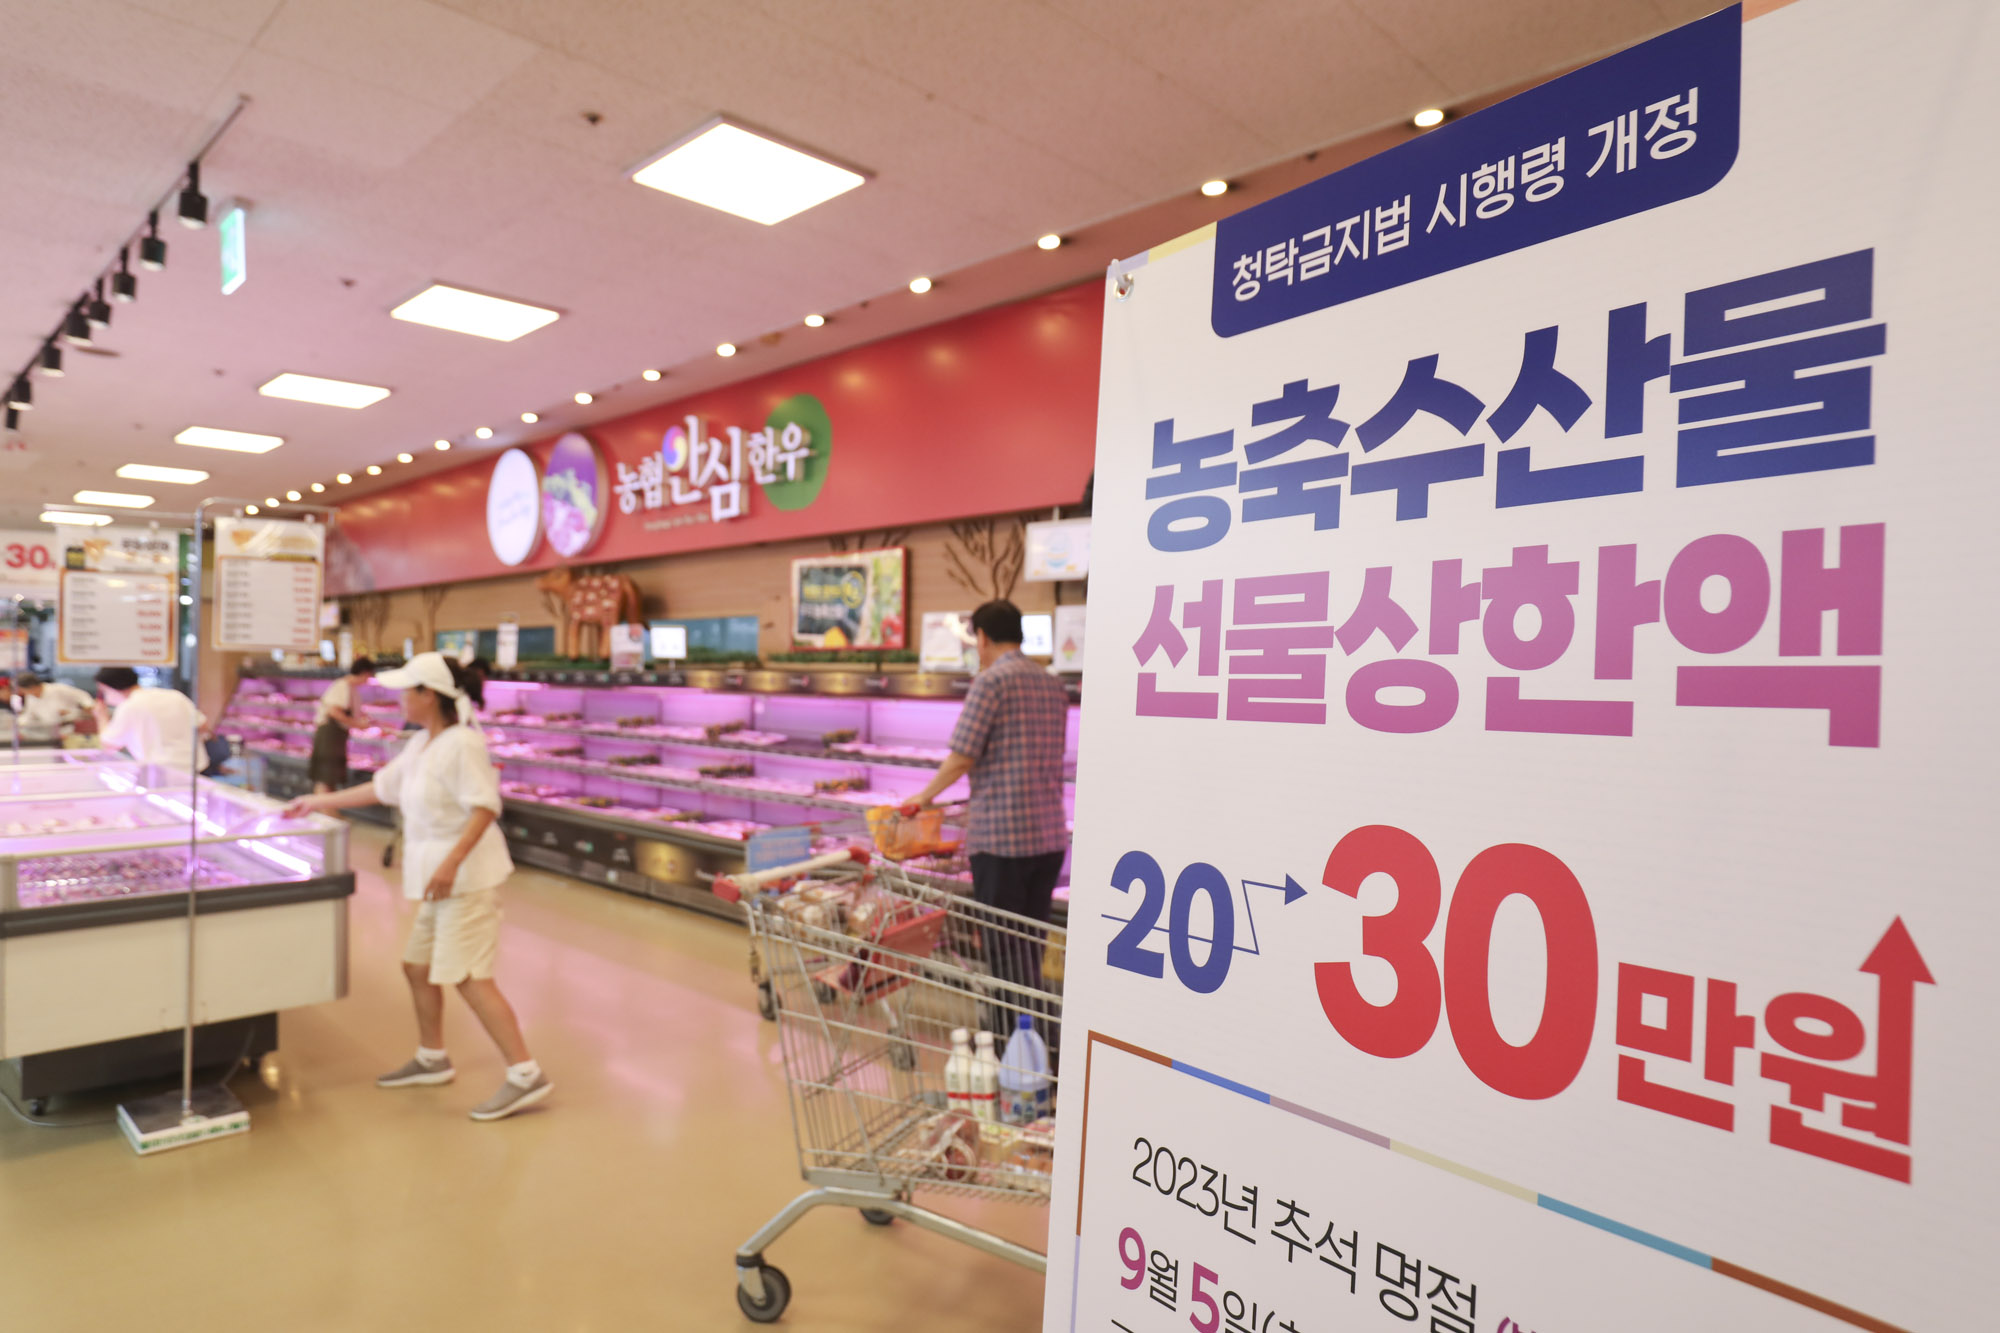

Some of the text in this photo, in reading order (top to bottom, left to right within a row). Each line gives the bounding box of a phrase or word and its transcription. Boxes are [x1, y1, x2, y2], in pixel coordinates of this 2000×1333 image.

[1232, 86, 1700, 302] 청탁금지법 시행령 개정
[1145, 247, 1887, 553] 농축수산물
[5, 543, 56, 571] 30
[1131, 521, 1887, 749] 선물상한액
[1105, 849, 1236, 995] 20
[1118, 1226, 1179, 1313] 9월
[1132, 1137, 1258, 1245] 2023년
[1270, 1199, 1359, 1295] 추석
